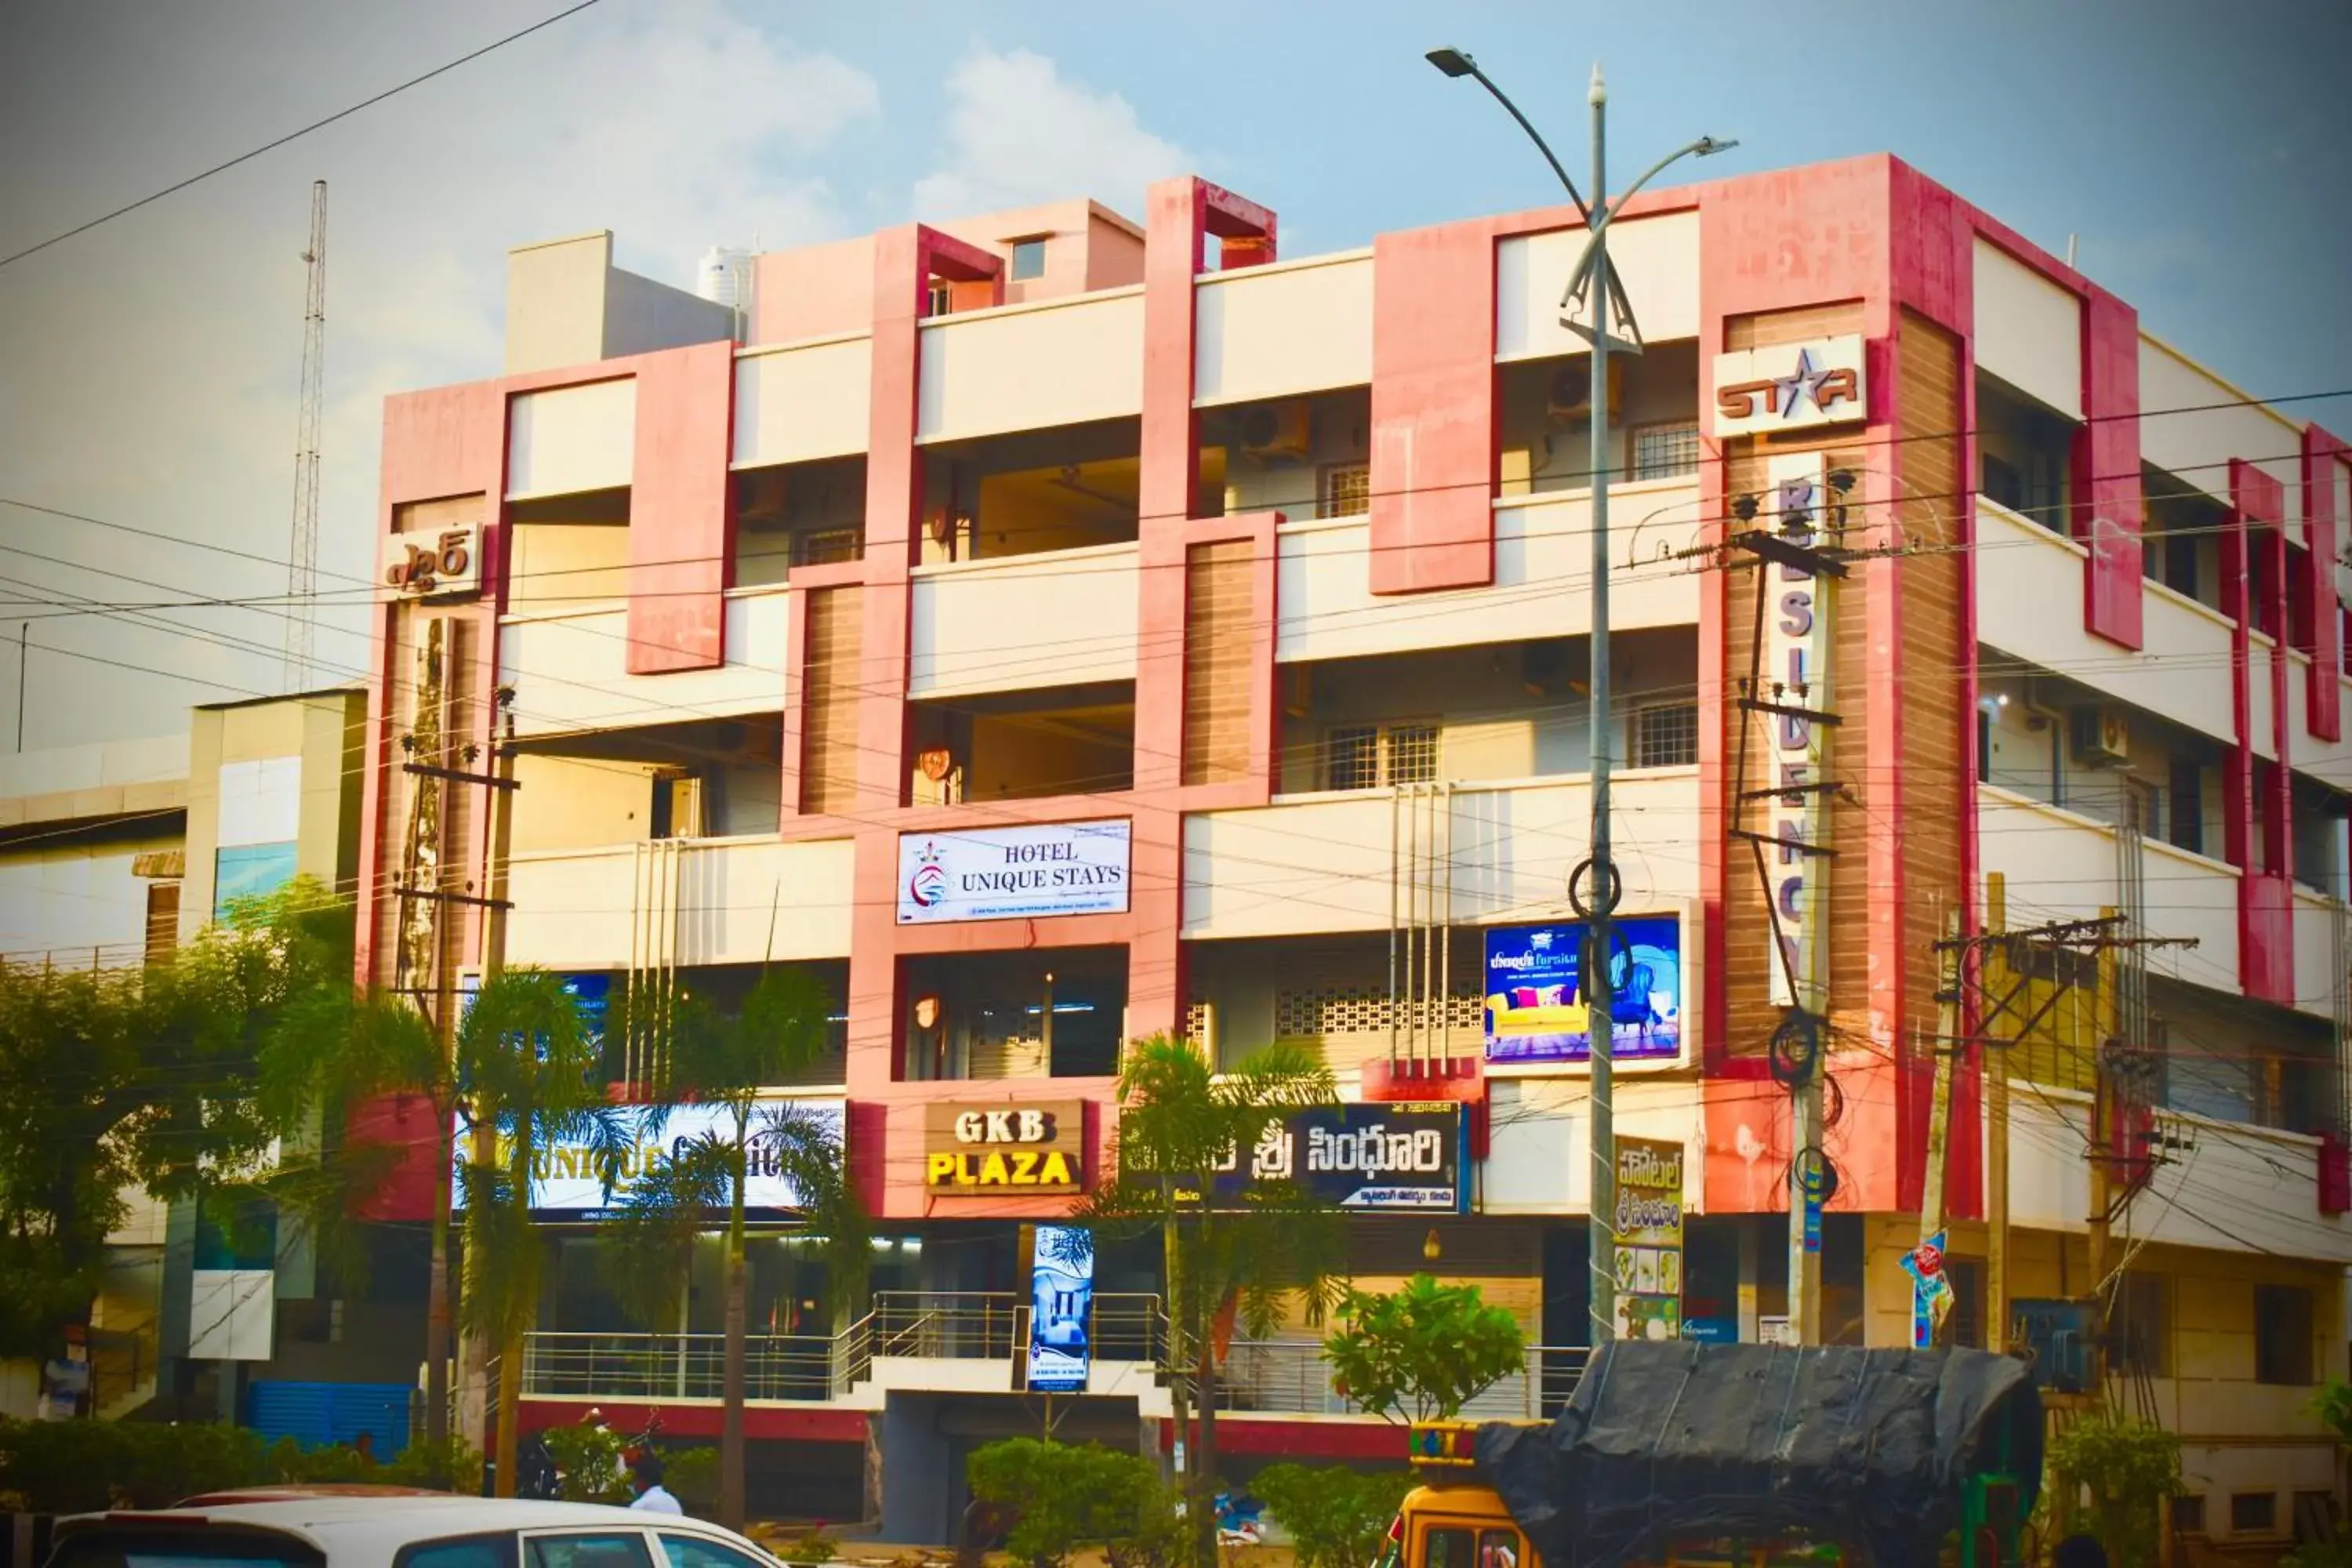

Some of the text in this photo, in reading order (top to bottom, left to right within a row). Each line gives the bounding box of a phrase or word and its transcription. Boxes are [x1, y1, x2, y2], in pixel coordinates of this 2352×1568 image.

[1716, 348, 1858, 419] STAR
[1005, 842, 1079, 863] HOTEL
[961, 866, 1121, 893] UNIQUE STAYS
[1536, 953, 1577, 965] furnitu
[955, 1109, 1045, 1143] GKB
[928, 1150, 1072, 1185] PLAZA
